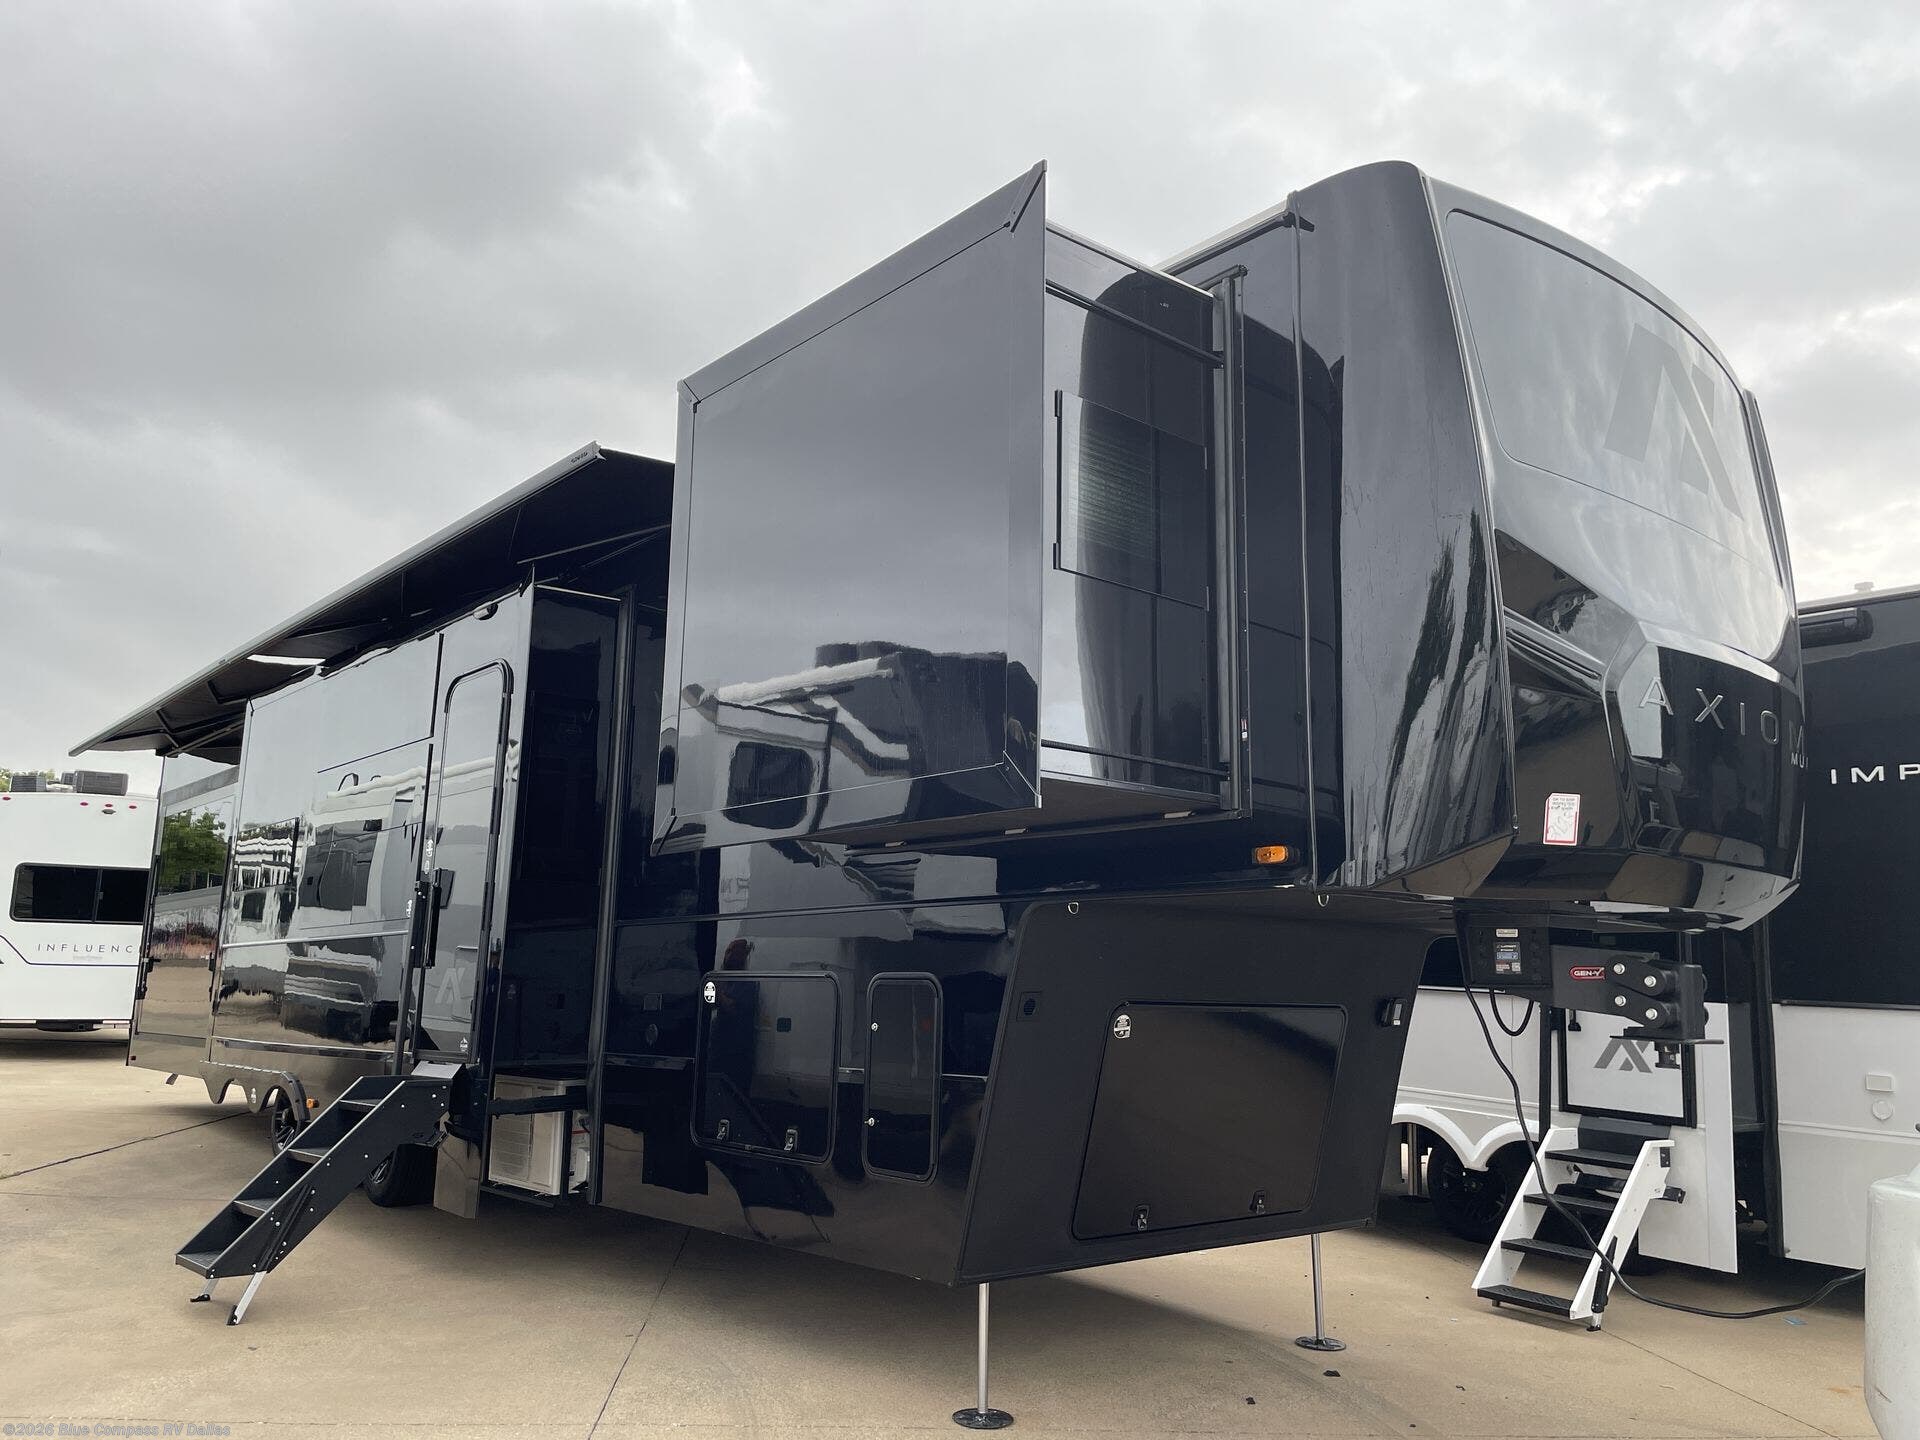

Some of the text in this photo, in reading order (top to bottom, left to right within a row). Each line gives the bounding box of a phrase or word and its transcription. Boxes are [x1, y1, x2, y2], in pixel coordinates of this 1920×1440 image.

[1638, 676, 1804, 753] AXIOM
[1830, 763, 1920, 784] IMP
[1573, 967, 1605, 977] GEN-Y
